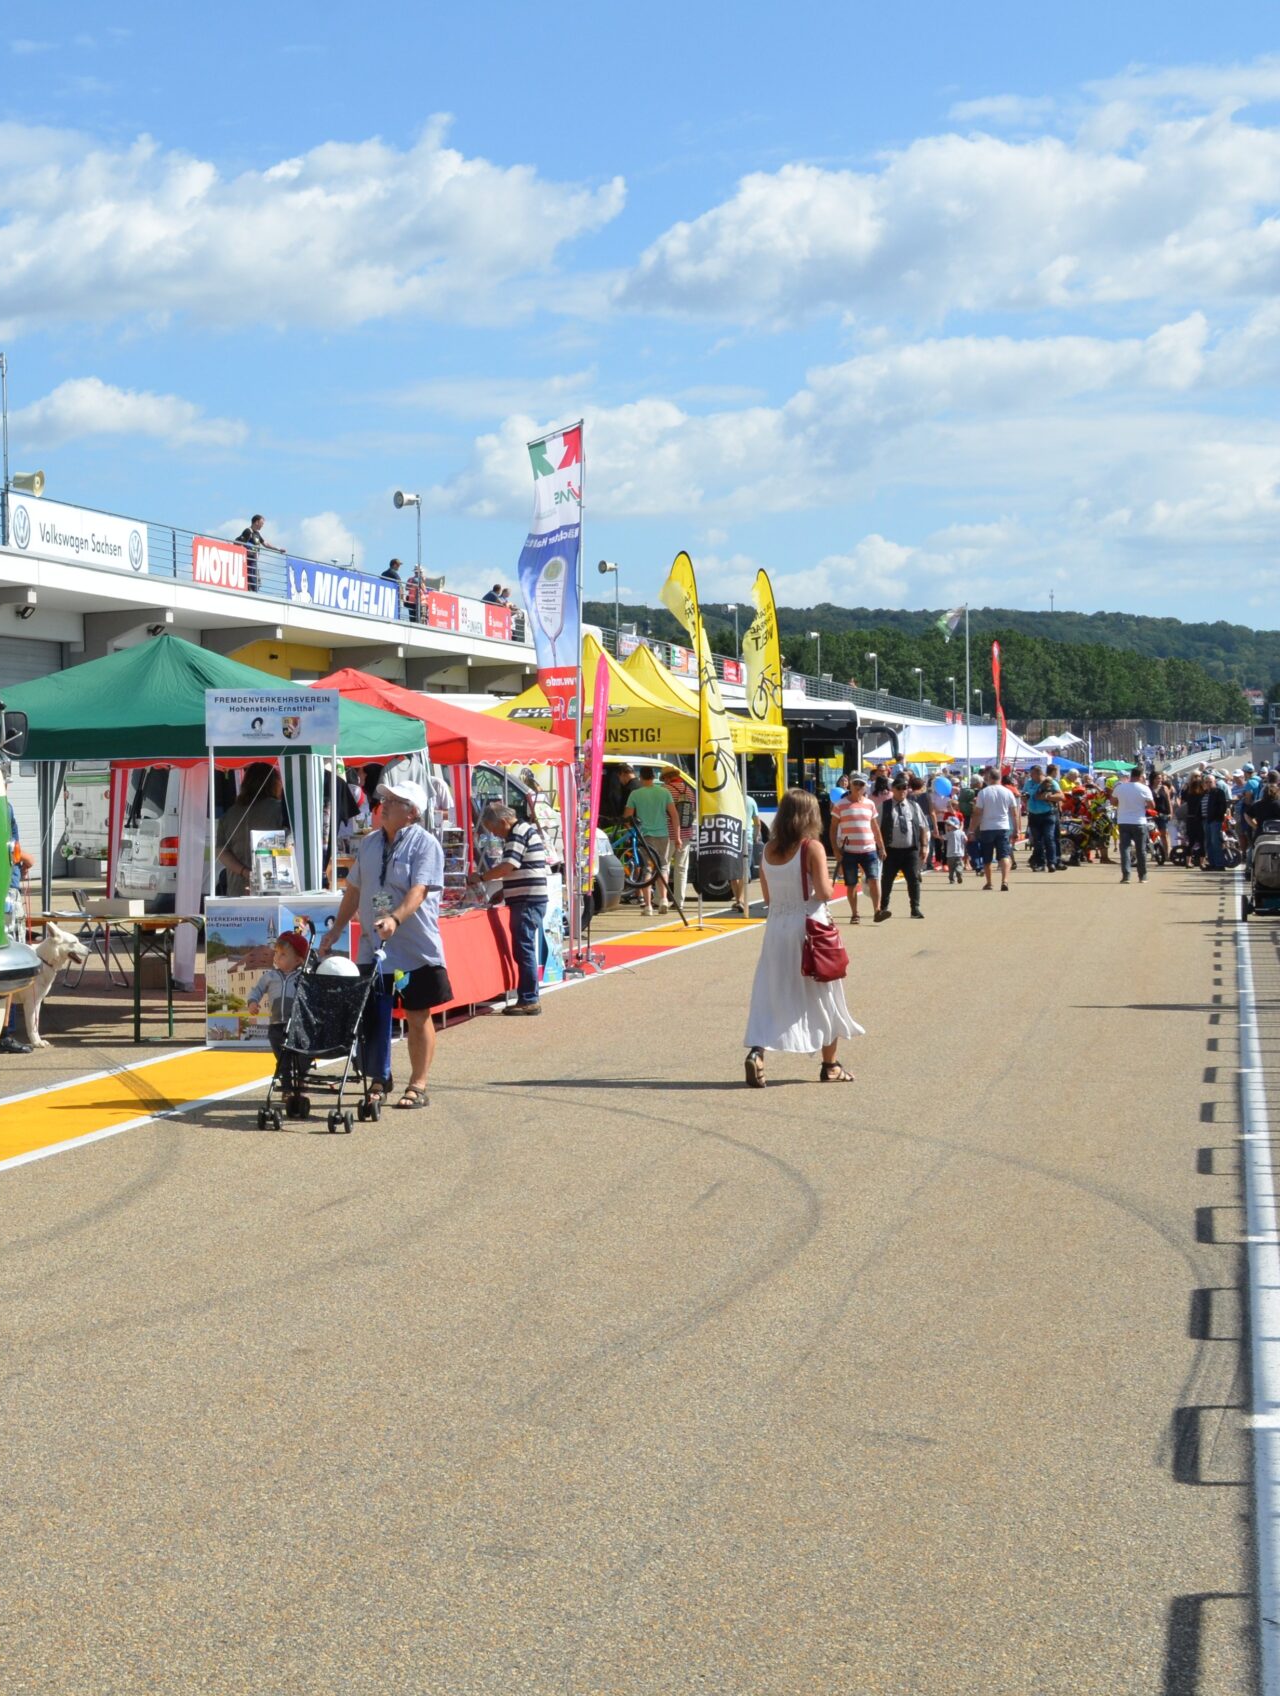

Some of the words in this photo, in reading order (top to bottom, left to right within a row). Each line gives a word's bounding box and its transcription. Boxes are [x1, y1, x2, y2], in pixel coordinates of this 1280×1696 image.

[39, 522, 89, 554] Volkswagen
[91, 533, 123, 557] Sachsen
[195, 544, 246, 590] MOTUL
[313, 570, 397, 619] MICHELIN
[214, 695, 331, 704] FREMDENVERKEHRSVEREIN
[229, 705, 315, 713] Hohenstein-Ernstthal
[586, 727, 661, 743] NSTIG!
